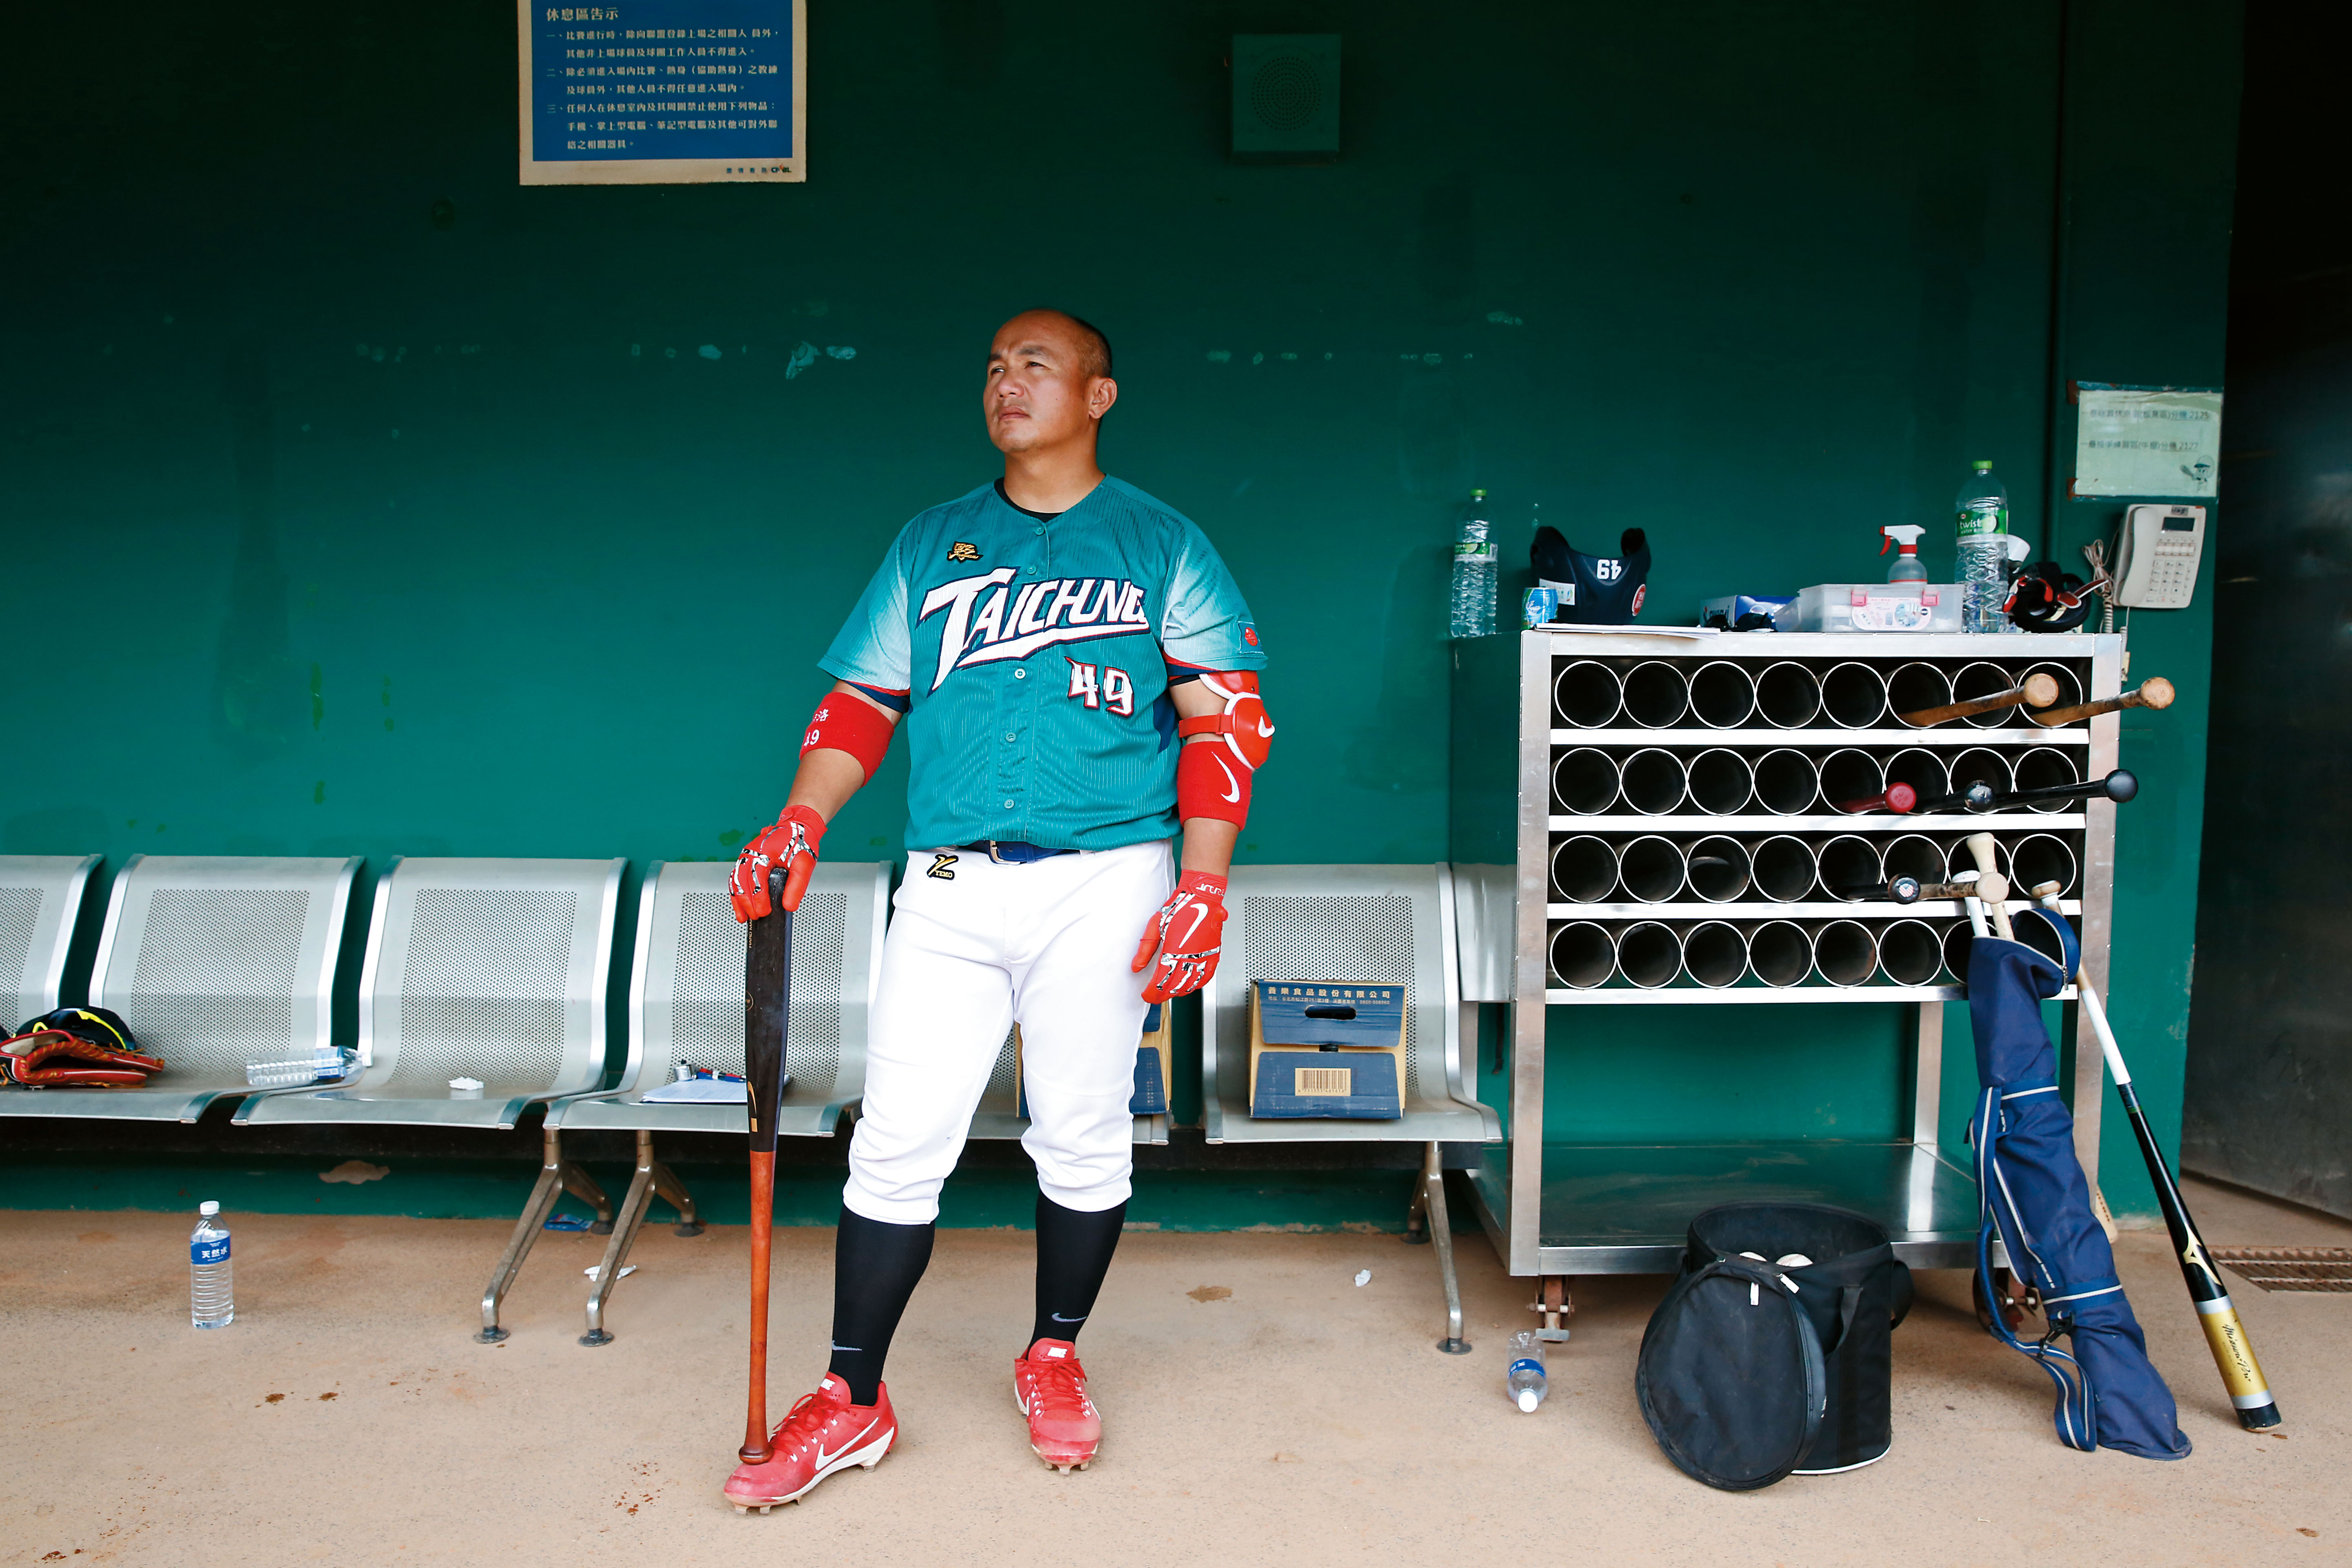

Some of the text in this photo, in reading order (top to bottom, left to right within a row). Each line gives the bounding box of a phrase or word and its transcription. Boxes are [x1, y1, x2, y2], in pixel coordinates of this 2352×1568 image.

[547, 7, 618, 21] 休息區告示
[1596, 559, 1622, 580] 49
[916, 566, 1149, 697] TAICHUNG
[1064, 657, 1134, 717] 49
[935, 870, 953, 878] YEMO
[201, 1246, 227, 1258] 天然水
[1047, 1347, 1068, 1358] NIKE
